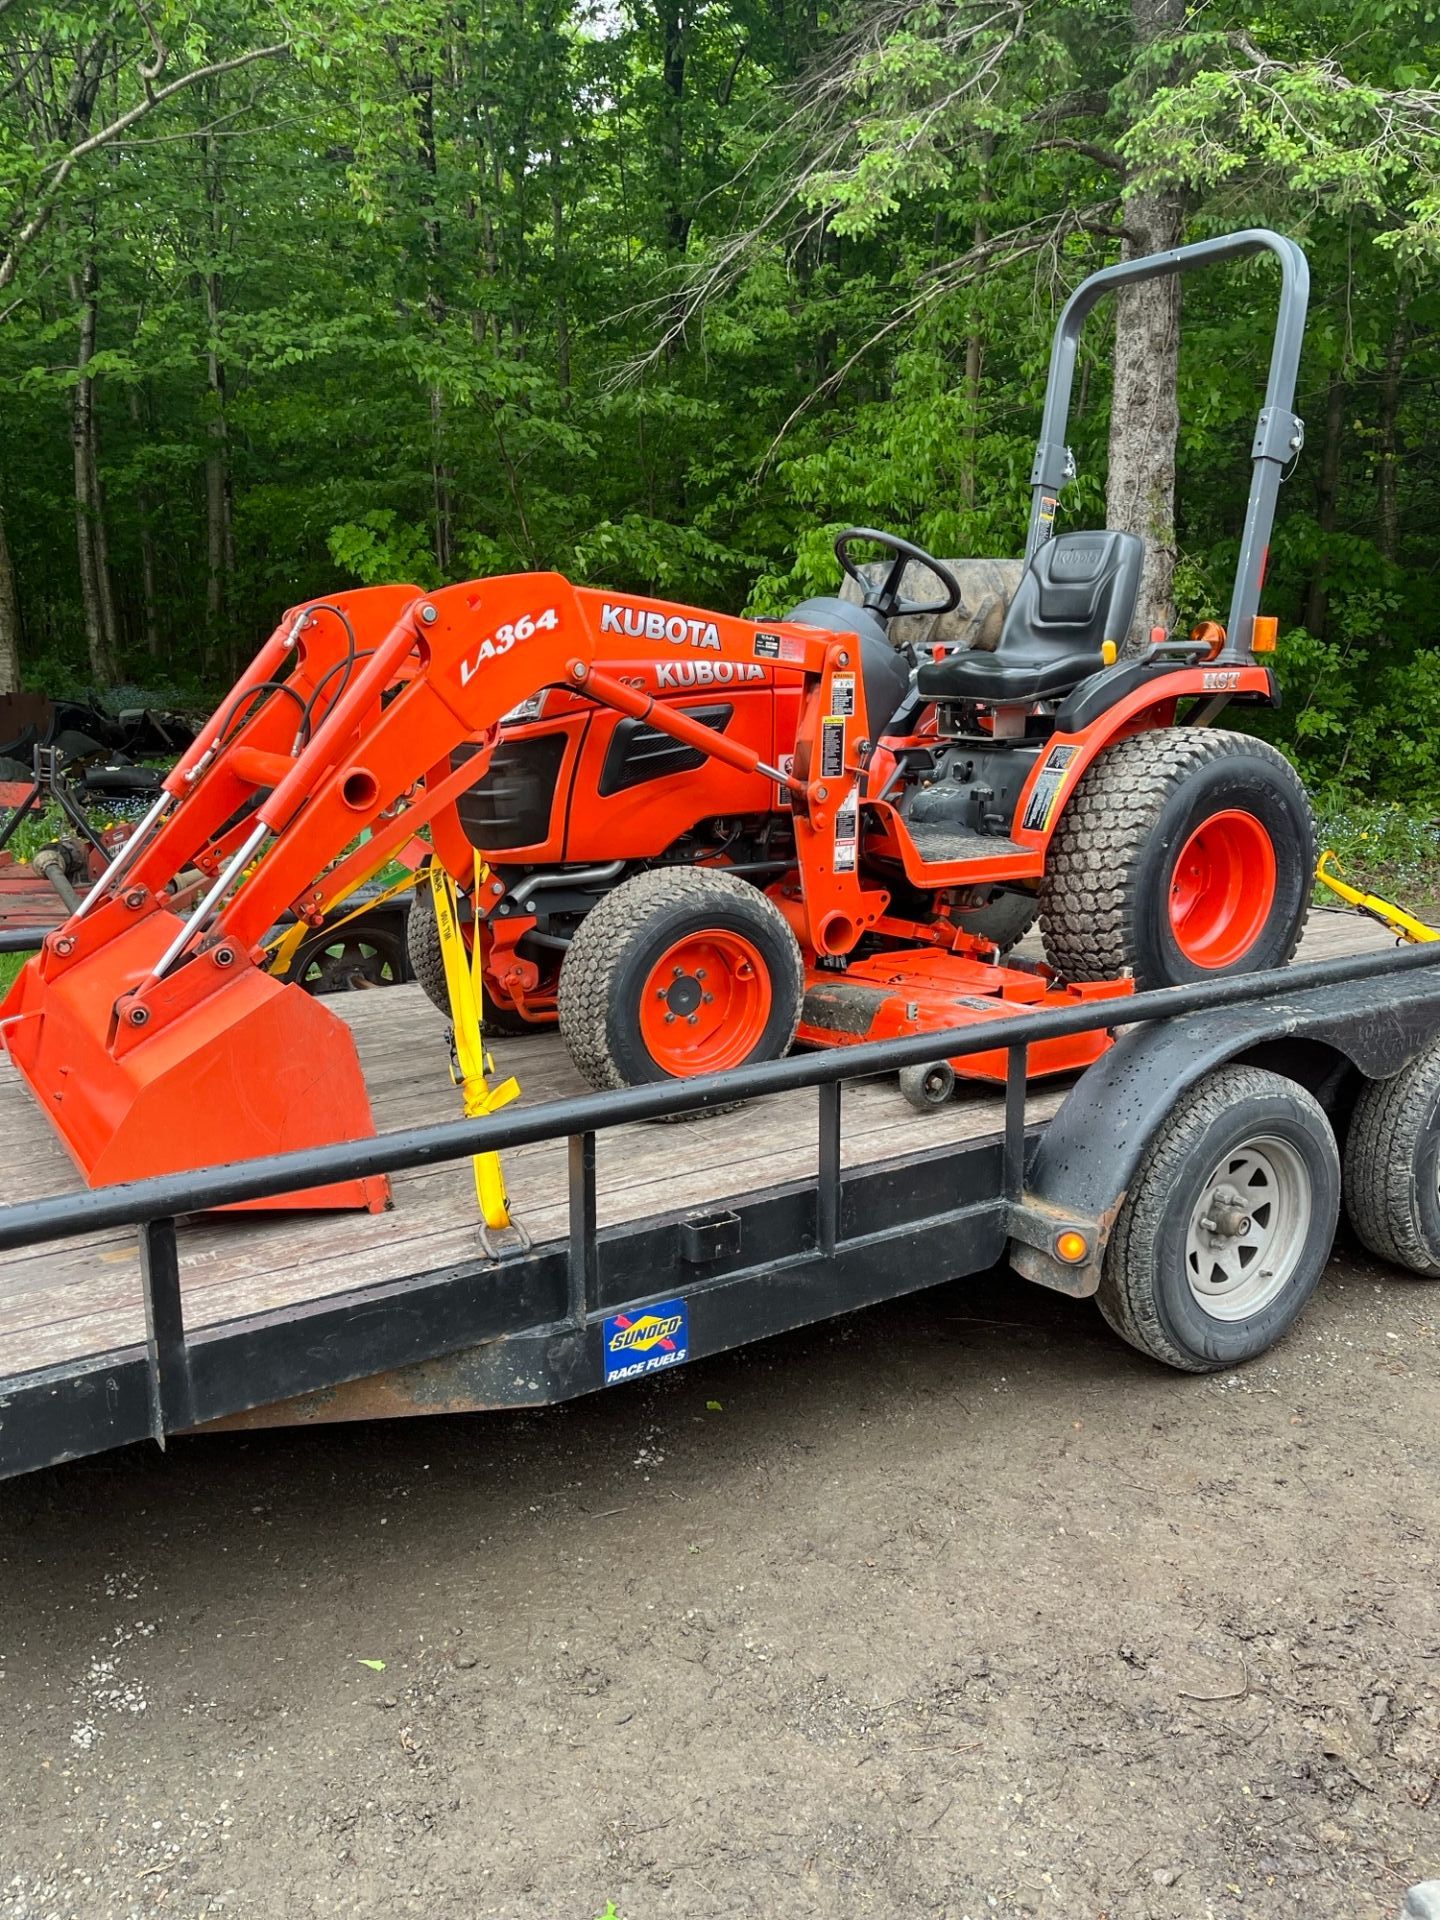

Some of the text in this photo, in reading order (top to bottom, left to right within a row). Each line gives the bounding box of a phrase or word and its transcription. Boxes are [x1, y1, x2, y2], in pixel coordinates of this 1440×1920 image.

[601, 603, 721, 651] KUBOTA
[460, 608, 558, 687] LA364
[1202, 671, 1241, 690] HST
[612, 1317, 680, 1350] SUNOCO
[608, 1349, 686, 1382] RACE FUELS
